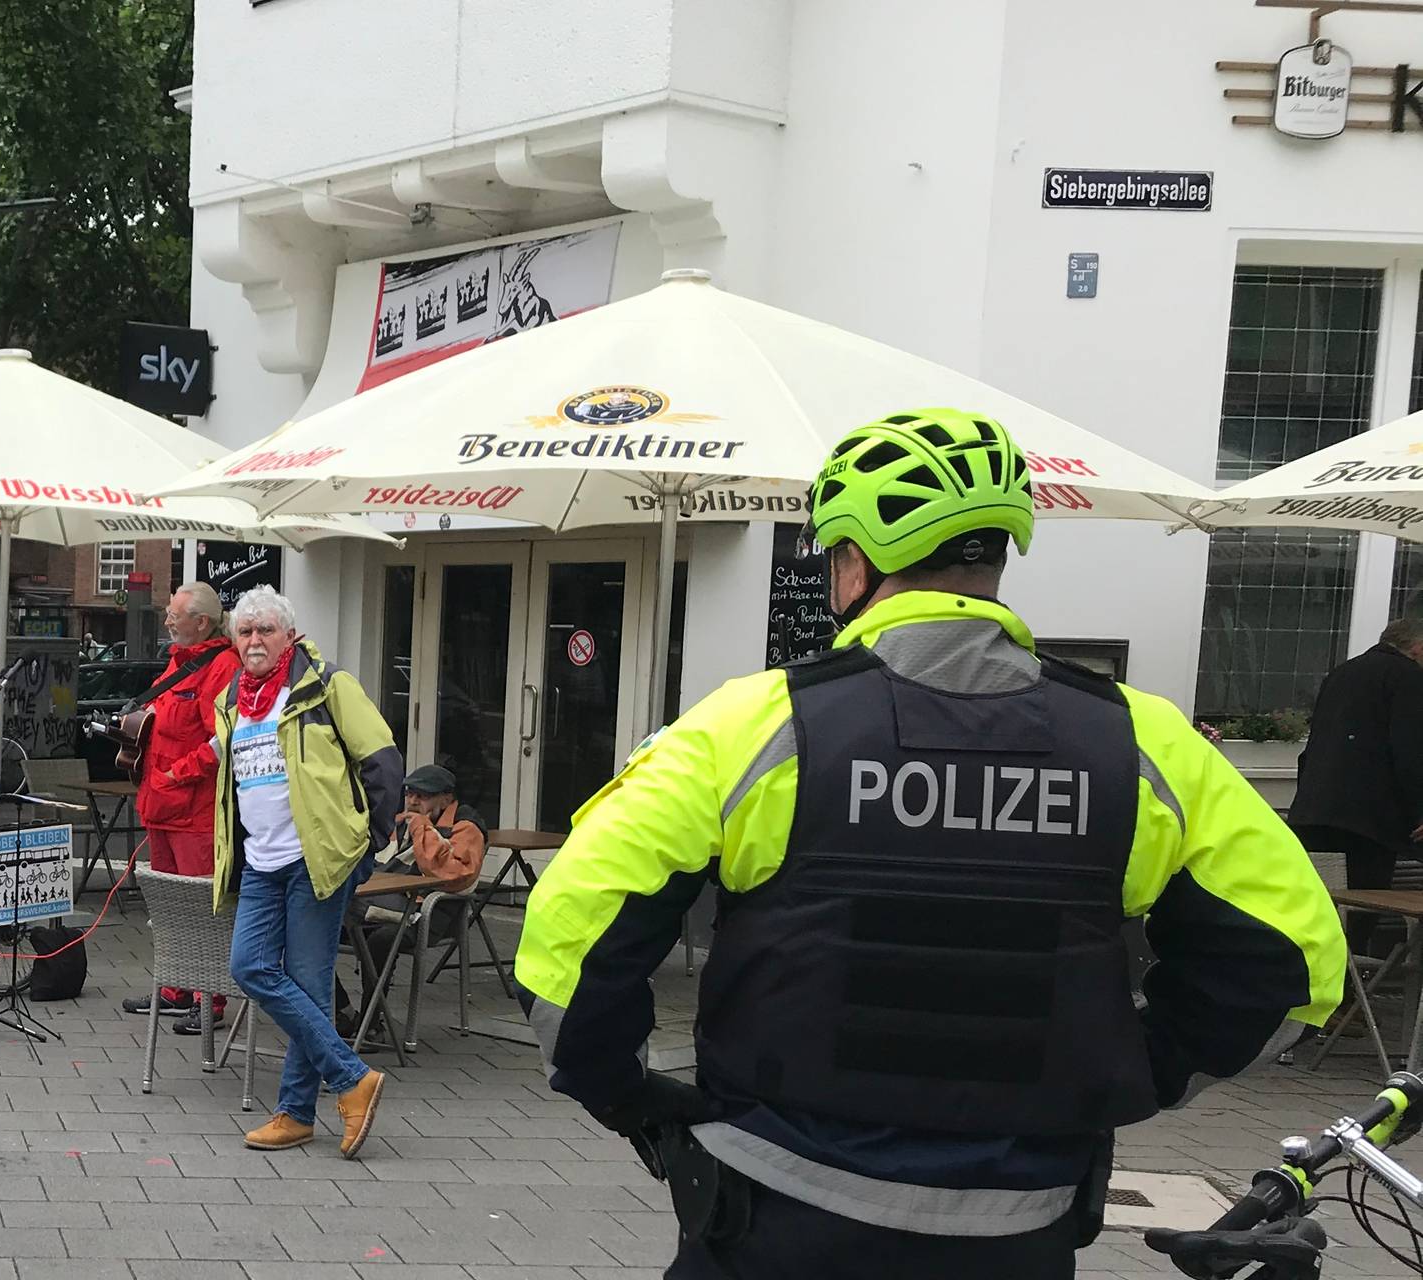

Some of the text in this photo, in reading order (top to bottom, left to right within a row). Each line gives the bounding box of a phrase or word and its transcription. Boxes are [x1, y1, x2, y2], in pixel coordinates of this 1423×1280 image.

[1283, 76, 1346, 101] Bitburger
[139, 344, 200, 394] sky
[457, 432, 747, 465] Benediktiner
[208, 544, 268, 580] Bitte ein Bit
[848, 759, 1090, 836] POLIZEI
[25, 828, 69, 847] BLEIBEN
